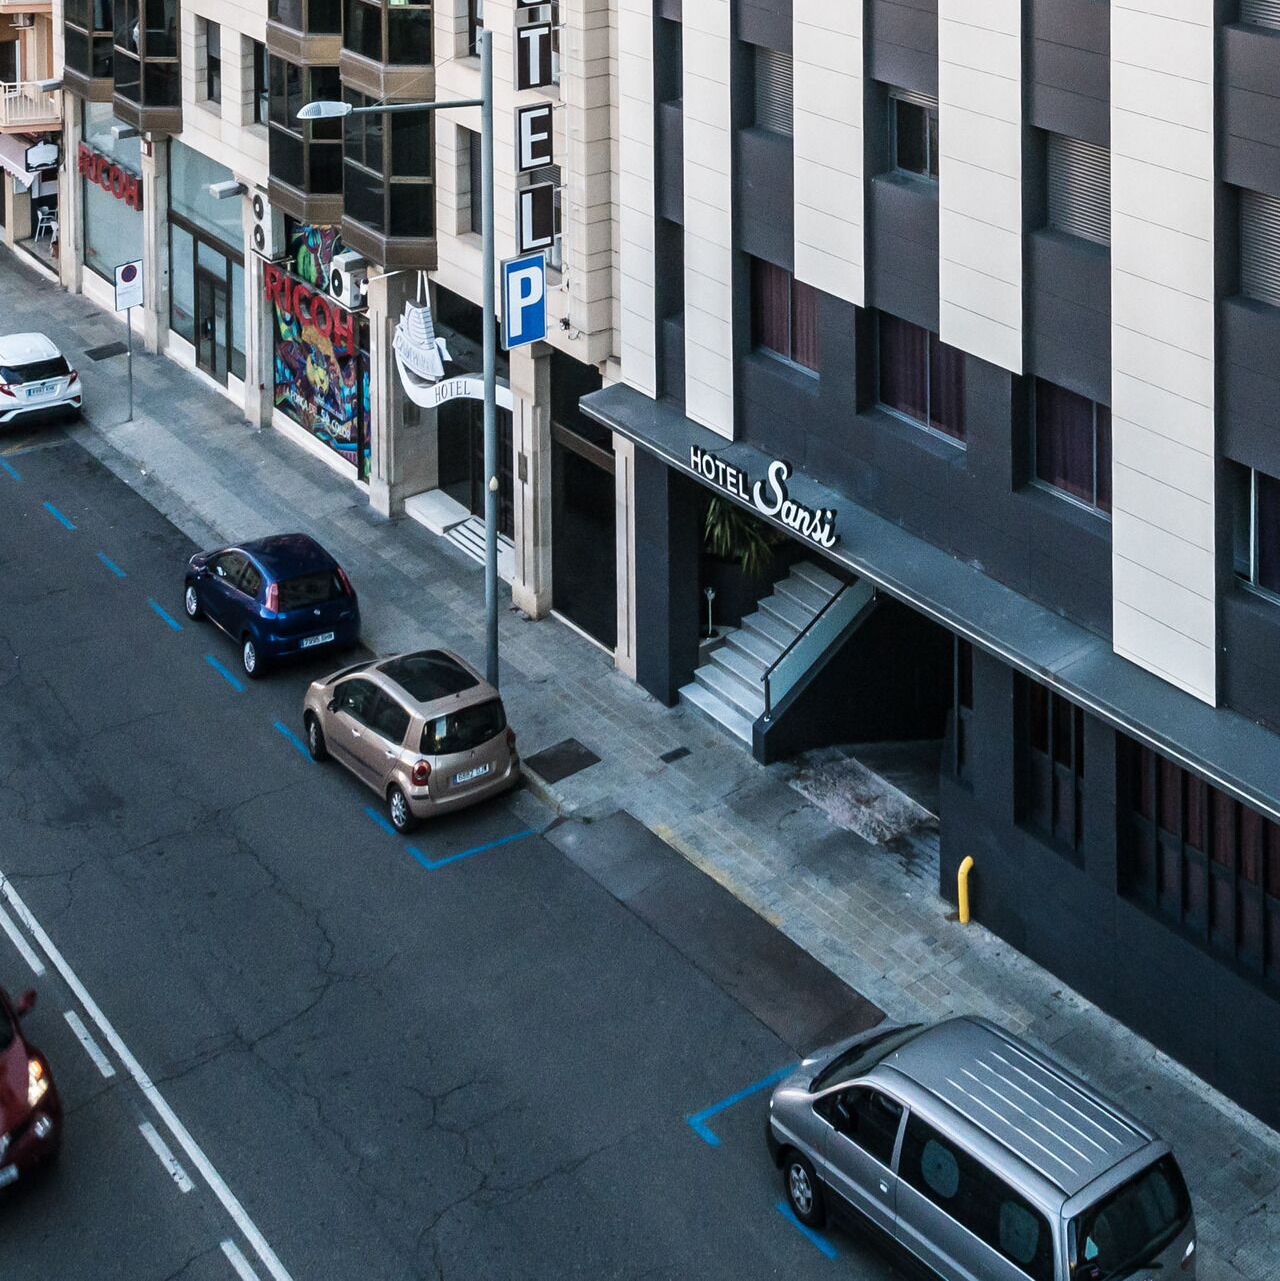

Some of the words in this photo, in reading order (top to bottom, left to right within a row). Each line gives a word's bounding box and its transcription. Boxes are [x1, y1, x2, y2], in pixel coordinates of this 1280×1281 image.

[79, 142, 143, 212] RICOH
[264, 265, 354, 356] RICOH
[509, 265, 543, 338] P
[434, 380, 471, 404] HOTEL
[690, 446, 750, 501] HOTEL
[753, 460, 837, 548] Sansi
